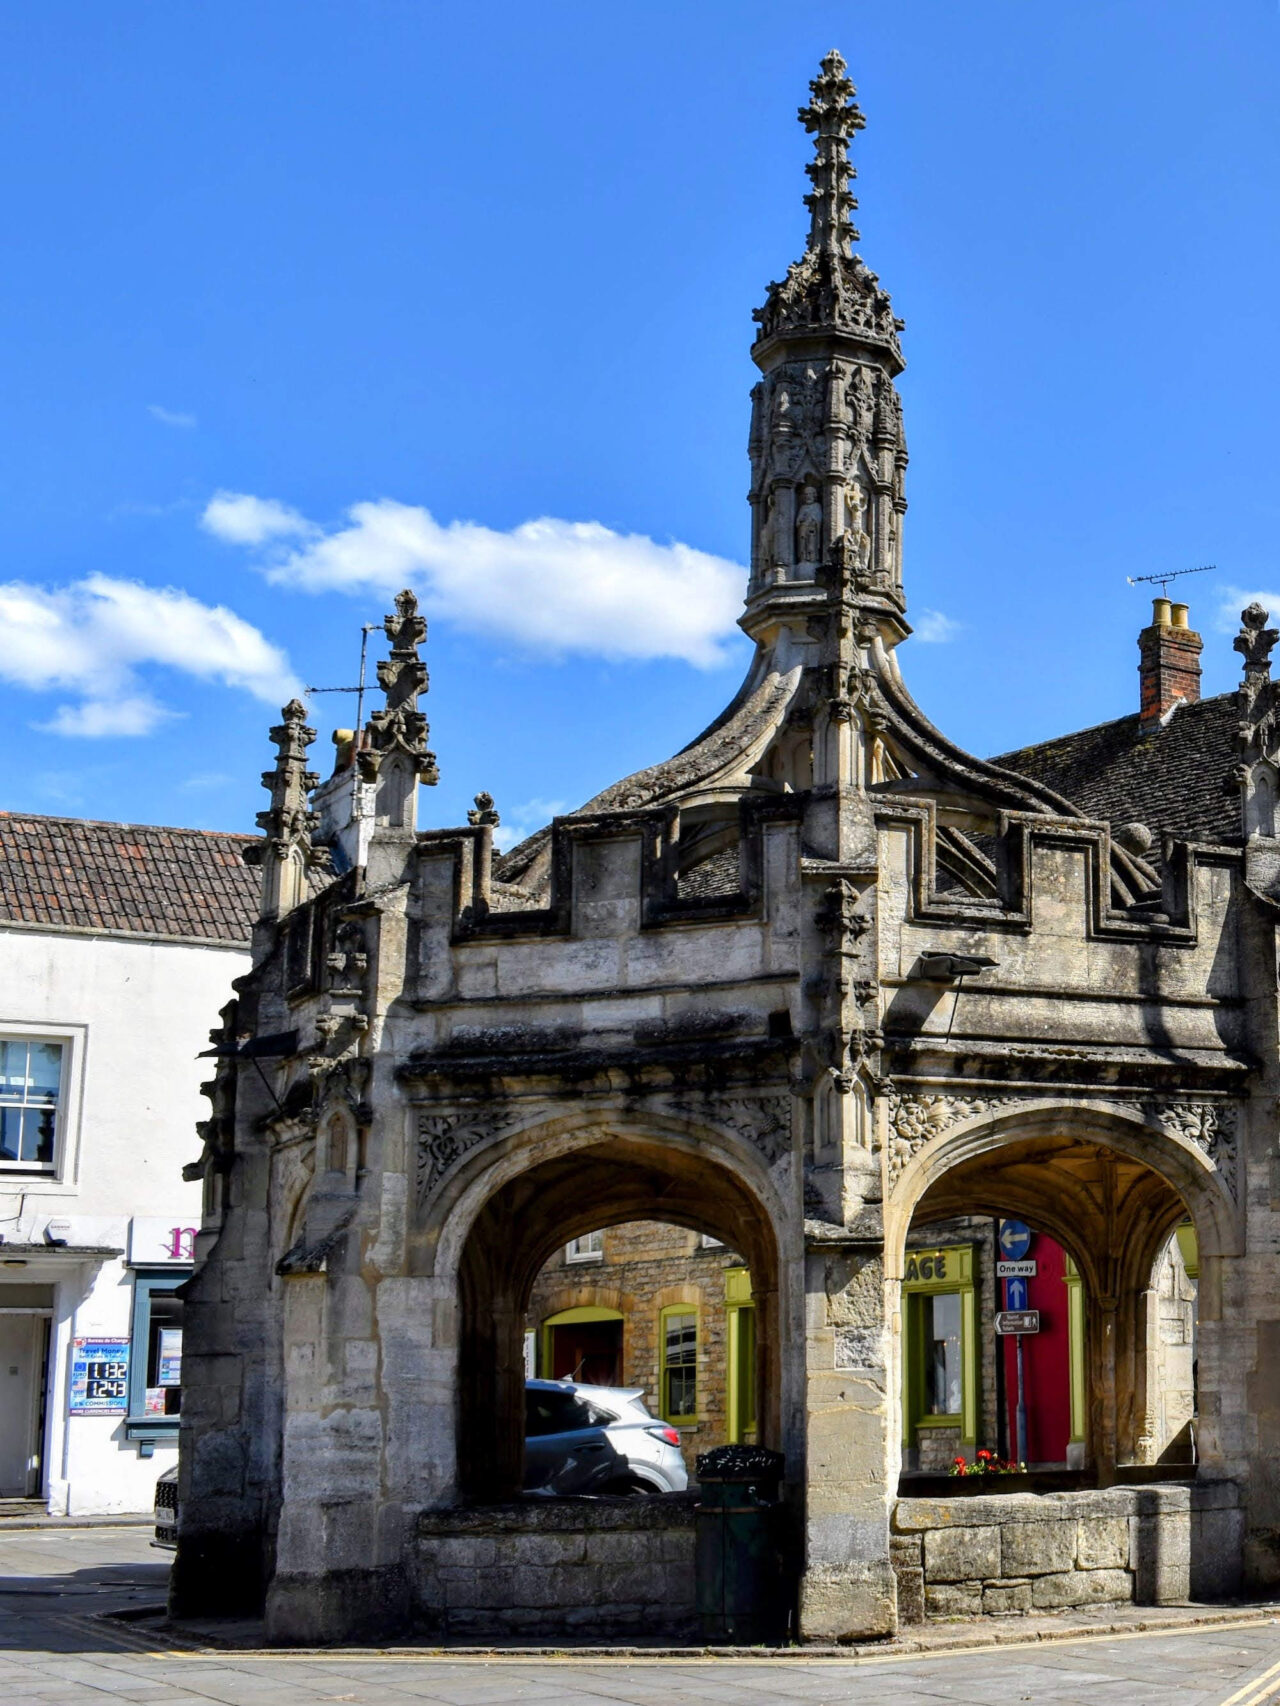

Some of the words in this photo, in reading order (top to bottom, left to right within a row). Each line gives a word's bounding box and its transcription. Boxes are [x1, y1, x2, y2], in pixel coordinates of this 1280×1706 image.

[903, 1255, 946, 1282] AGE
[1000, 1264, 1015, 1273] One
[1017, 1265, 1034, 1273] way
